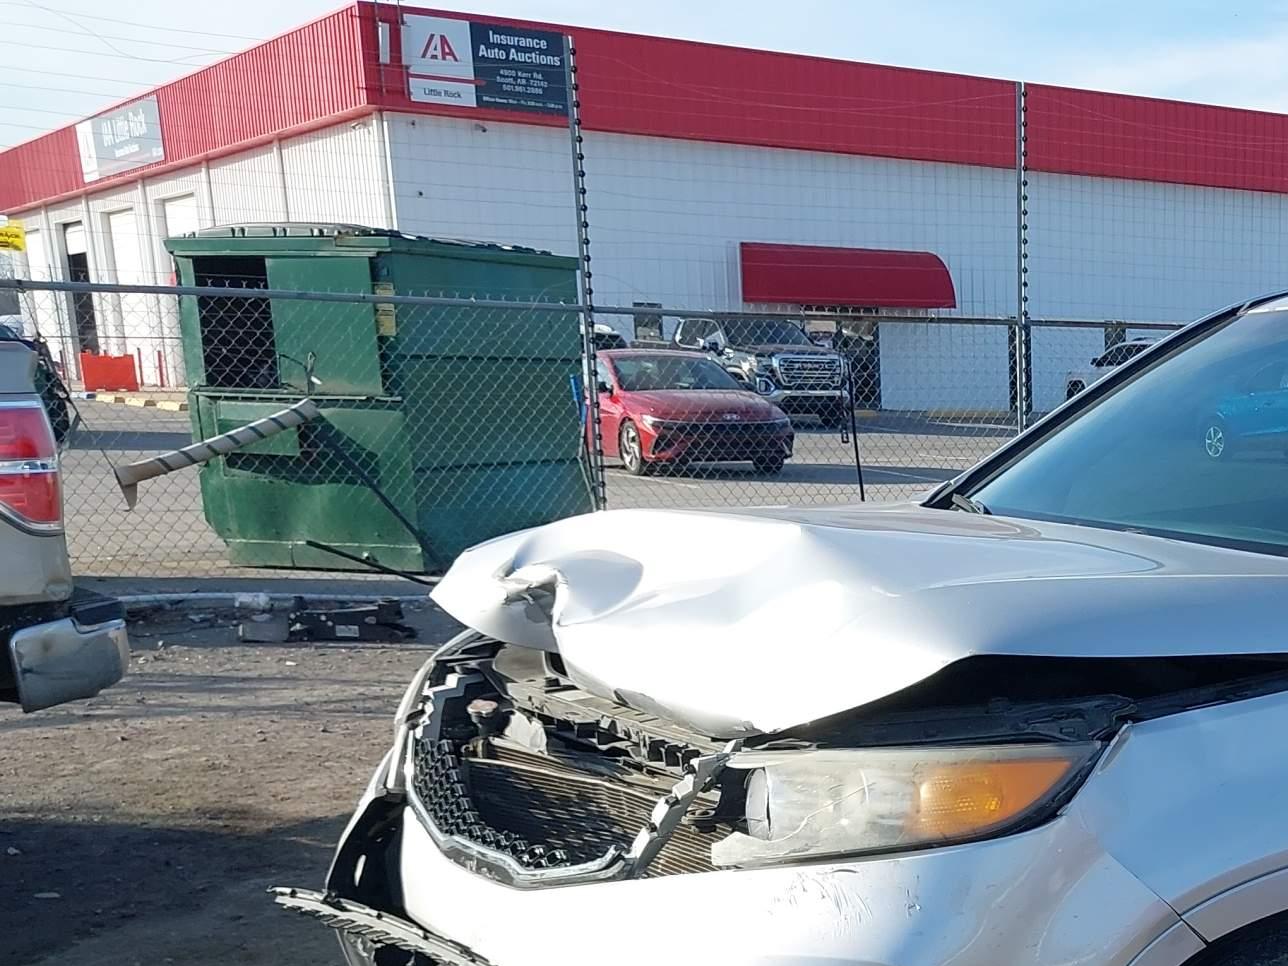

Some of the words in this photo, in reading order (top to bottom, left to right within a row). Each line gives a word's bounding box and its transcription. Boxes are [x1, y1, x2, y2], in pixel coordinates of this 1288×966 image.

[489, 30, 547, 49] Insurance
[479, 44, 506, 60] Auto
[509, 48, 561, 66] Auctions
[424, 87, 442, 97] Little
[444, 89, 462, 99] Rock
